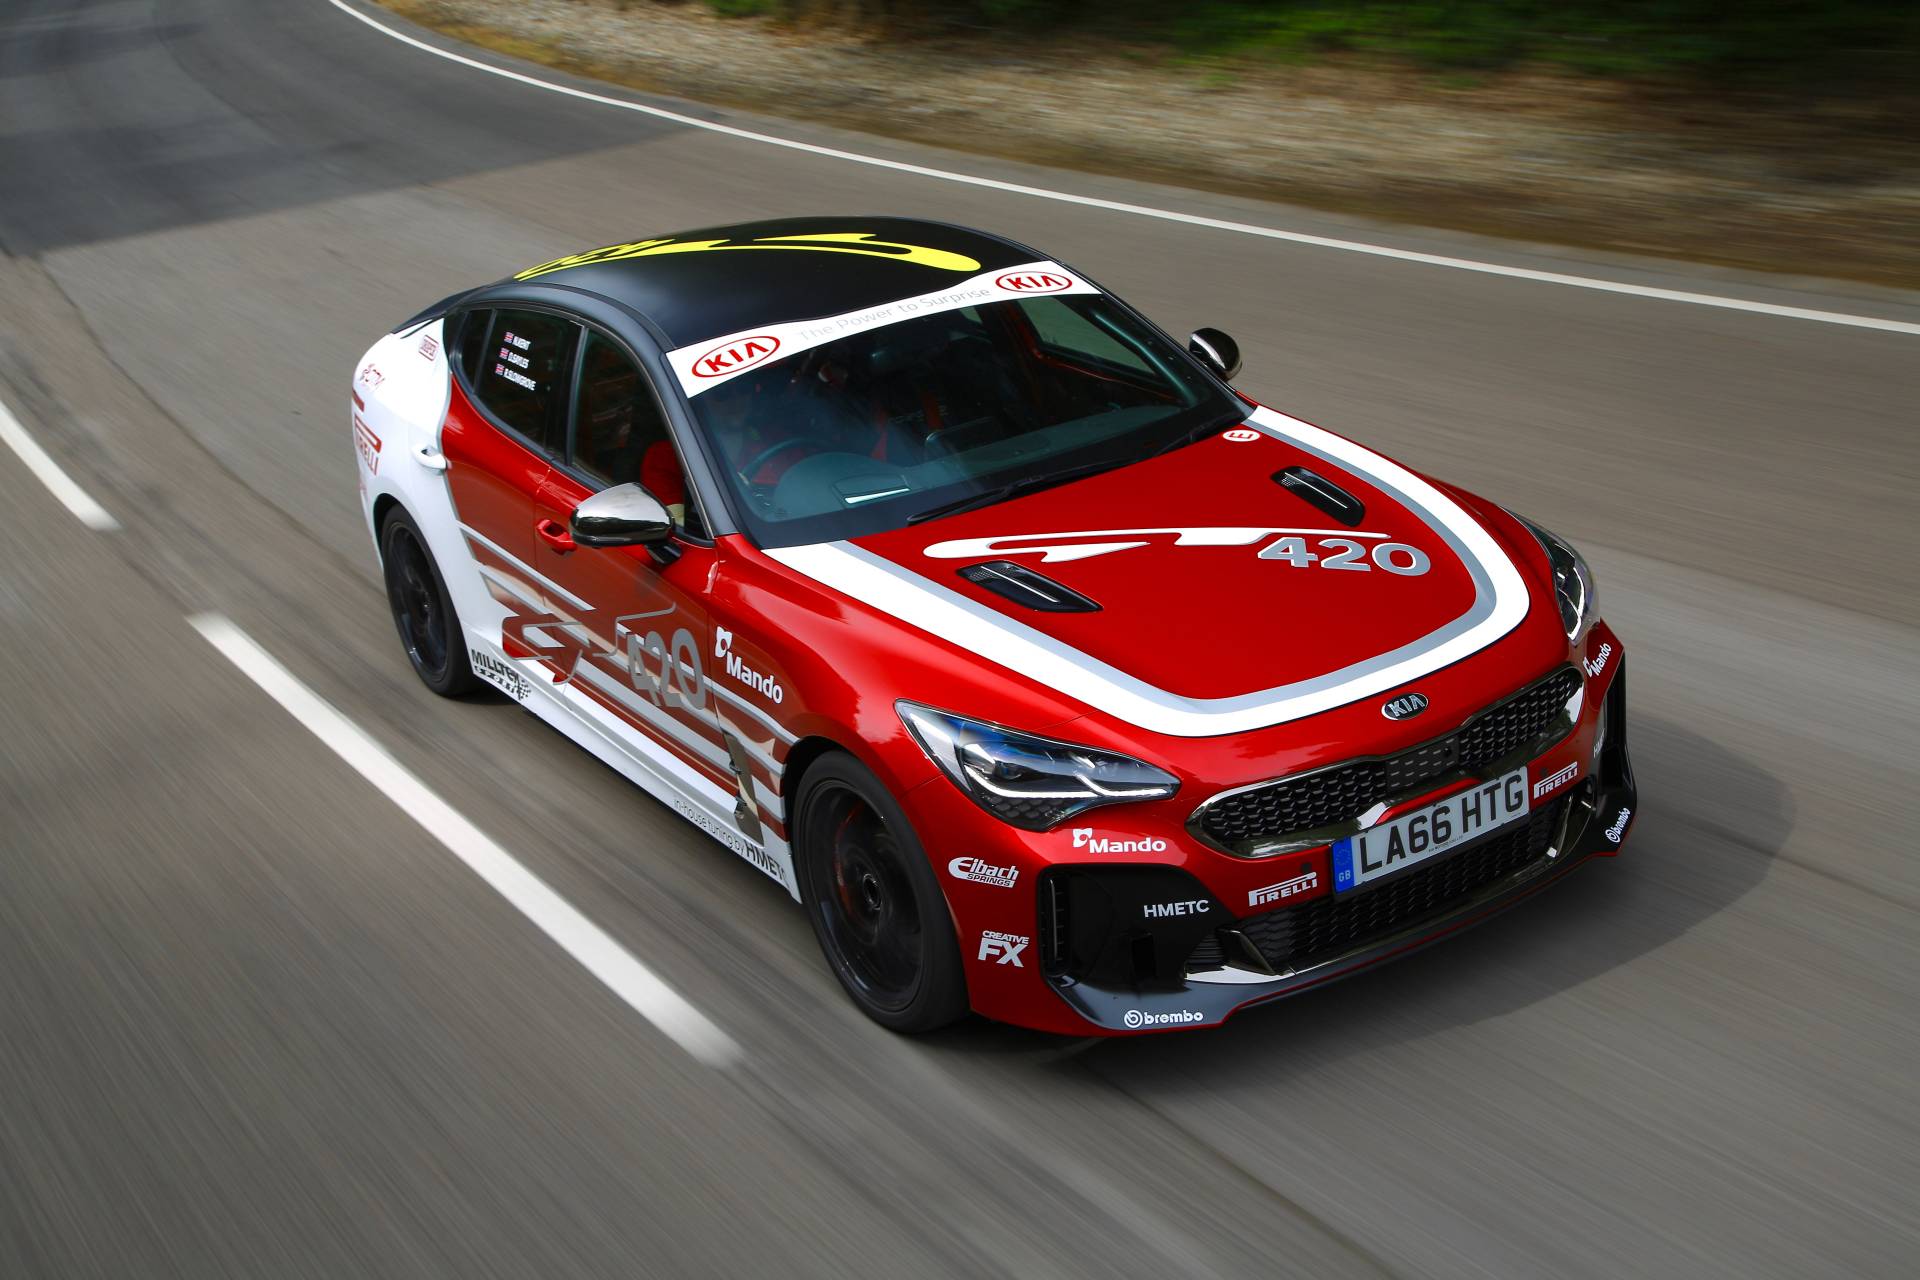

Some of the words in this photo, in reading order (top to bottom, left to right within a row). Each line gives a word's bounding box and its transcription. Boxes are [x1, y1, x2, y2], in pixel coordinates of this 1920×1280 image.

[1006, 275, 1063, 290] KIA
[800, 324, 833, 341] The
[836, 309, 893, 329] Power
[898, 301, 918, 314] to
[919, 287, 991, 308] Surprise
[704, 341, 769, 373] KIA
[1257, 536, 1431, 577] 420
[627, 627, 706, 711] 420
[1591, 642, 1612, 677] Mando
[726, 651, 783, 704] Mando
[1387, 694, 1426, 717] KIA
[1533, 761, 1578, 800] PIRELLI
[1359, 805, 1452, 874] LA66
[1461, 774, 1524, 833] HTG
[1089, 838, 1167, 853] Mando
[948, 856, 1020, 882] Eibach
[967, 873, 1012, 888] SPRINGS
[1338, 870, 1351, 883] GB
[1248, 871, 1318, 907] PIRELLI
[1143, 899, 1211, 918] HMETC
[978, 937, 1028, 968] FX
[982, 930, 1030, 945] CREATIVE
[1144, 1009, 1204, 1025] brembo
